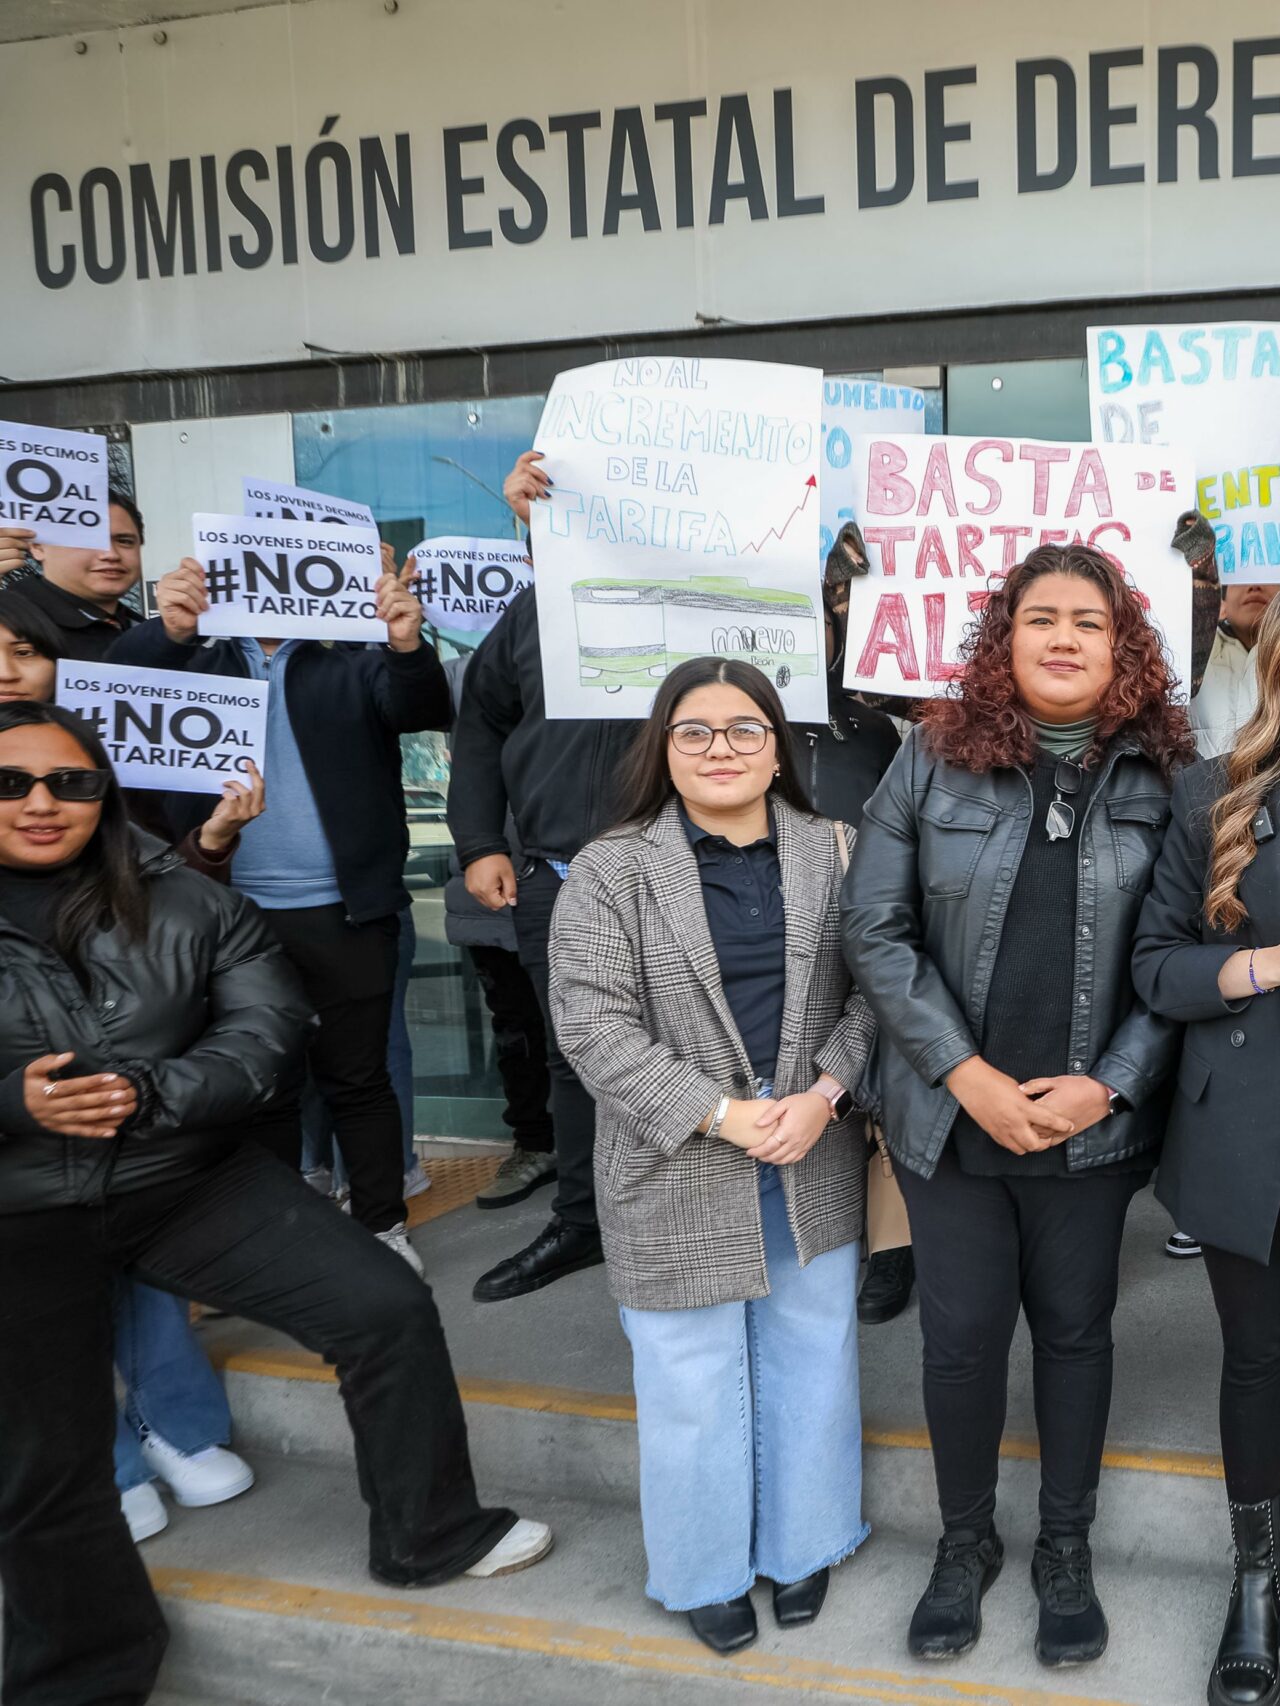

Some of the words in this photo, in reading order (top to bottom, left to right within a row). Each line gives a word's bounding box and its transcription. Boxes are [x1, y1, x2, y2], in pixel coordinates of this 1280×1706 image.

[30, 115, 417, 290] COMISIÓN
[442, 88, 826, 250] ESTATAL
[854, 65, 980, 210] DE
[613, 358, 662, 388] NO
[665, 358, 708, 390] AL
[540, 390, 813, 466] INCREMENTO
[1099, 400, 1170, 446] DE
[21, 442, 100, 464] DECIMOS
[63, 483, 98, 502] AL
[606, 457, 648, 486] DE
[655, 460, 699, 496] LA
[866, 440, 1113, 518] BASTA
[1135, 468, 1177, 492] DE
[247, 488, 271, 502] LOS
[273, 493, 323, 511] JOVENES
[325, 504, 371, 523] DECIMOS
[534, 487, 737, 556] TARIFA
[199, 531, 229, 544] LOS
[232, 533, 304, 550] JOVENES
[308, 539, 375, 556] DECIMOS
[434, 549, 485, 561] JOVENES
[204, 550, 345, 604] #NO
[345, 575, 376, 593] AL
[412, 561, 514, 606] #NO
[242, 595, 379, 619] TARIFAZO
[64, 678, 101, 692] LOS
[104, 682, 182, 700] JOVENES
[186, 690, 260, 709] DECIMOS
[221, 728, 255, 747] AL
[107, 743, 256, 774] TARIFAZO
